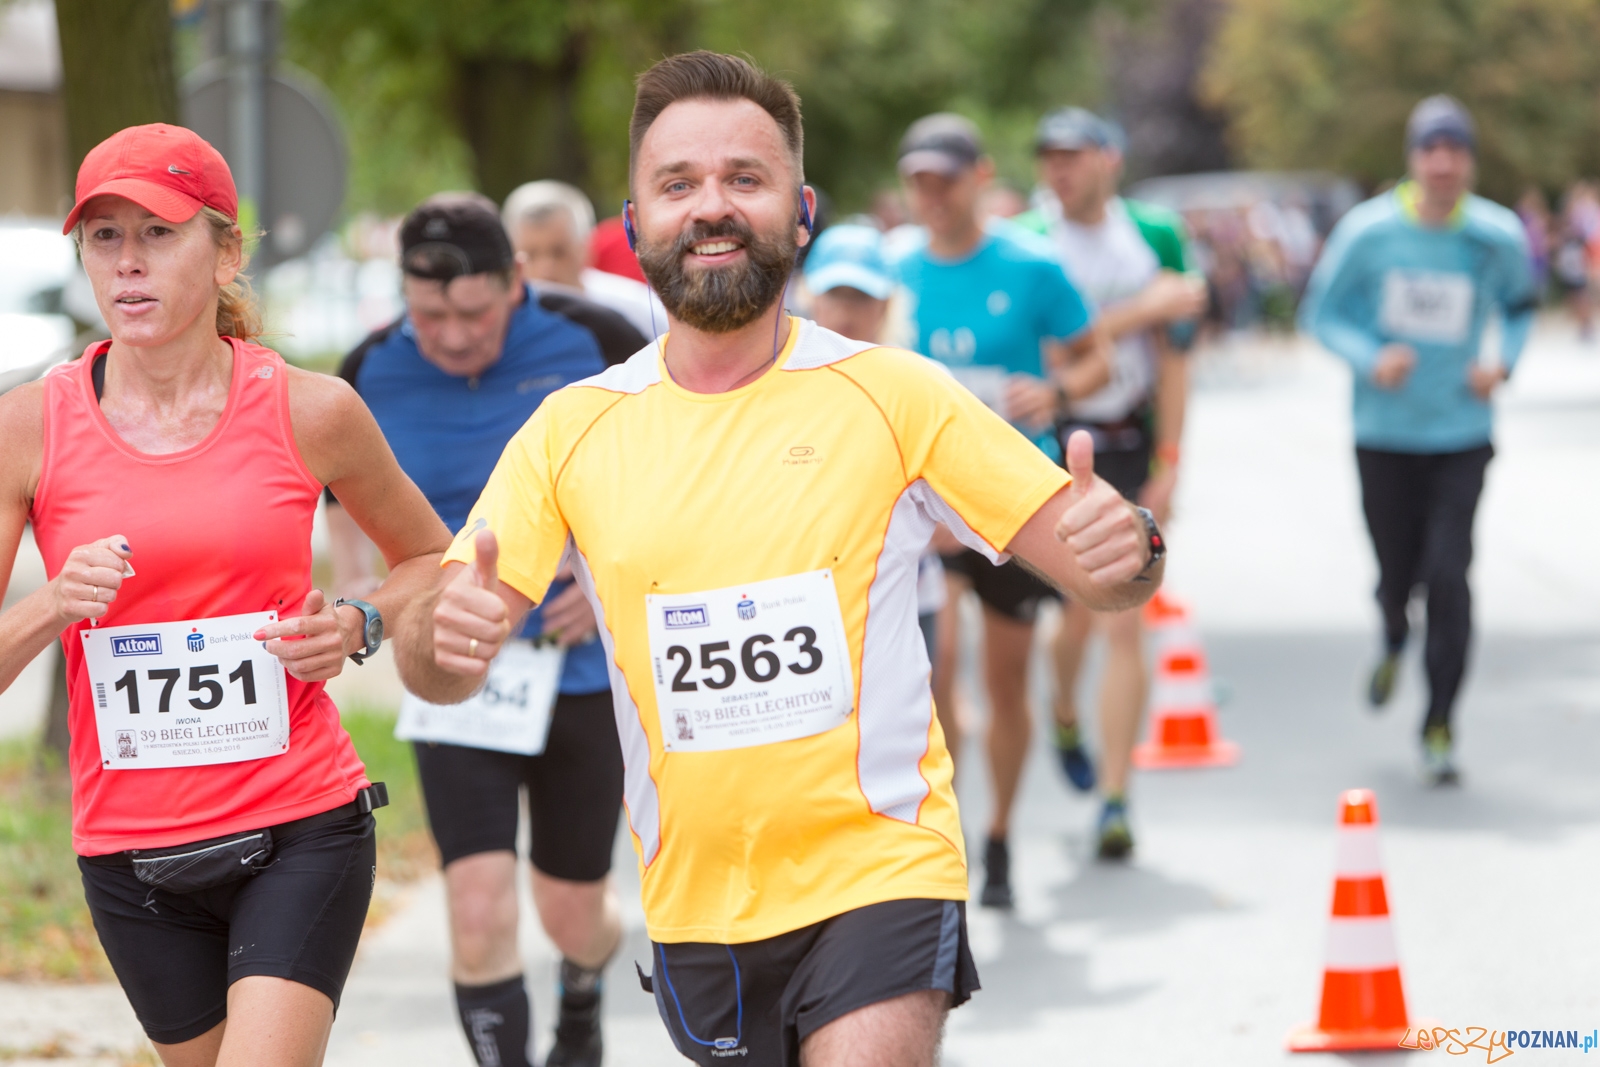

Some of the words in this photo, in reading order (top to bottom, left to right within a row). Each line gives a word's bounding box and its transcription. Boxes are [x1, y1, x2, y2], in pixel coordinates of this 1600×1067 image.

[209, 635, 229, 645] Bank
[230, 632, 252, 642] Polski
[666, 625, 823, 692] 2563
[114, 659, 257, 714] 1751
[720, 690, 769, 704] SEBASTIAN
[694, 709, 711, 724] 39
[714, 704, 751, 721] BIEG
[756, 686, 833, 714] LECHITÓW
[140, 730, 156, 742] 39
[160, 727, 193, 741] BIEG
[197, 717, 270, 738] LECHITÓW
[175, 716, 202, 725] IWONA
